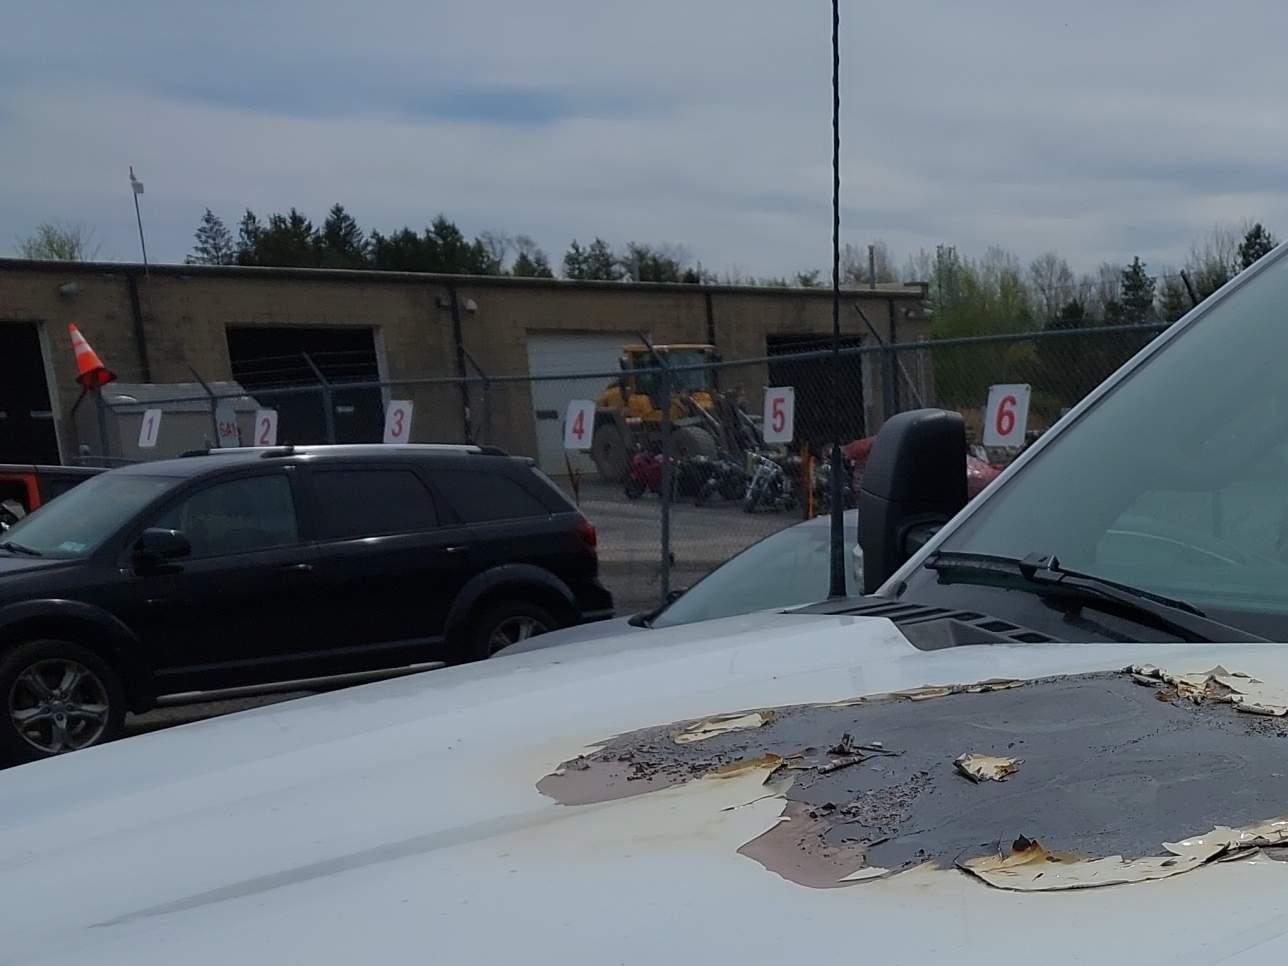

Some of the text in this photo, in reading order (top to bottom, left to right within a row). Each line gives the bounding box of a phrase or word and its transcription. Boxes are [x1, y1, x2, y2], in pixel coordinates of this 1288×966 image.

[146, 416, 155, 441] 1
[391, 408, 405, 437] 3
[571, 409, 585, 440] 4
[772, 397, 785, 433] 5
[995, 395, 1017, 436] 6
[260, 417, 271, 445] 2
